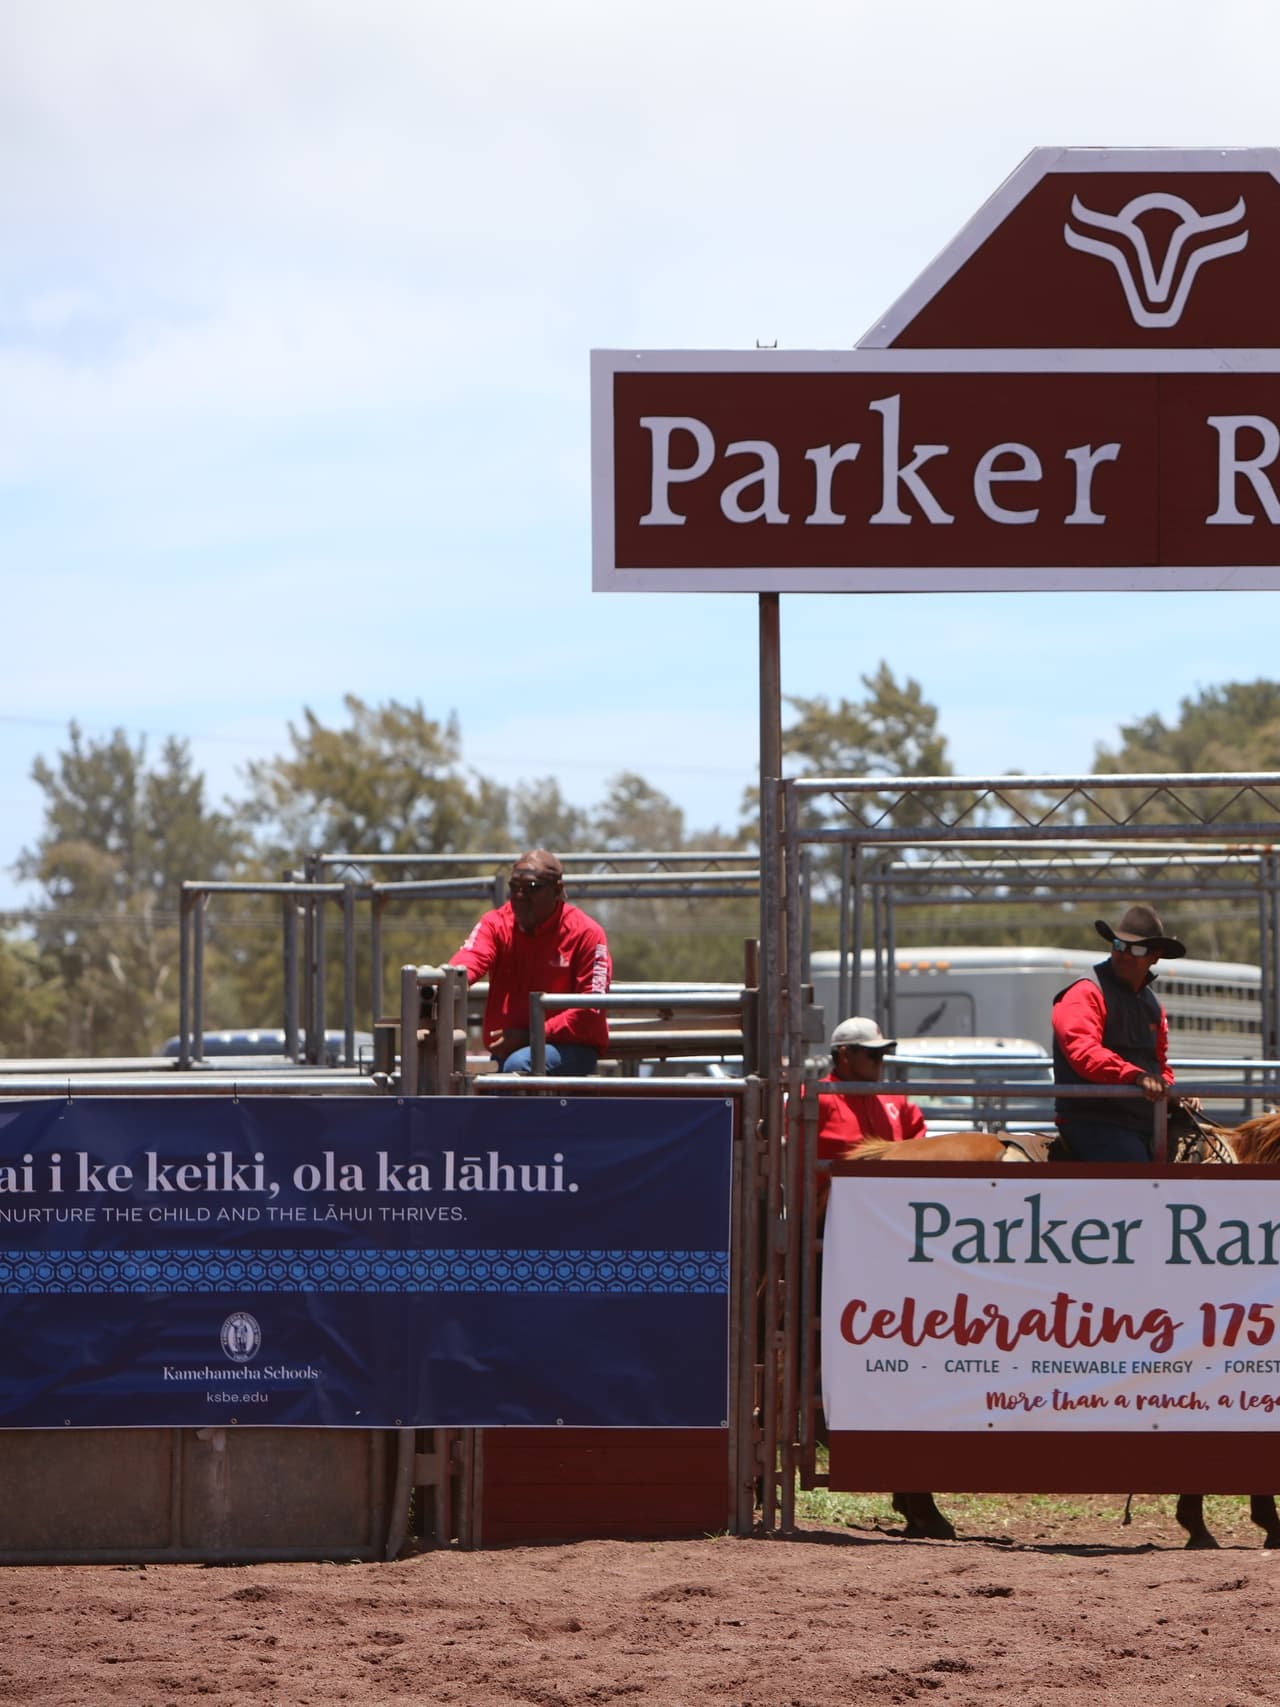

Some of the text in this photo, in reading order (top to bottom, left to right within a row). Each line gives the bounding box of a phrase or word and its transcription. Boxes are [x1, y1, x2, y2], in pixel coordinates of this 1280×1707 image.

[638, 394, 1122, 526] Parker
[48, 1153, 64, 1192] i
[76, 1152, 134, 1192] ke
[145, 1152, 280, 1199] keiki,
[293, 1152, 365, 1192] ola
[377, 1152, 432, 1192] ka
[443, 1152, 579, 1192] lāhui.
[0, 1203, 468, 1222] NURTURE THE CHILD AND THE LĀHUI THRIVES.
[907, 1193, 1142, 1265] Parker
[840, 1292, 1184, 1353] Celebrating
[1200, 1302, 1276, 1348] 175
[163, 1365, 319, 1381] Kamehameha Schools
[865, 1359, 909, 1373] LAND
[944, 1360, 1000, 1374] CATTLE
[1031, 1360, 1127, 1374] RENEWABLE
[1131, 1360, 1193, 1374] ENERGY
[206, 1391, 269, 1403] ksbe.edu
[986, 1391, 1048, 1412] More
[1052, 1388, 1110, 1412] than
[1114, 1394, 1130, 1409] a
[1136, 1391, 1210, 1412] ranch,
[1217, 1394, 1234, 1409] a
